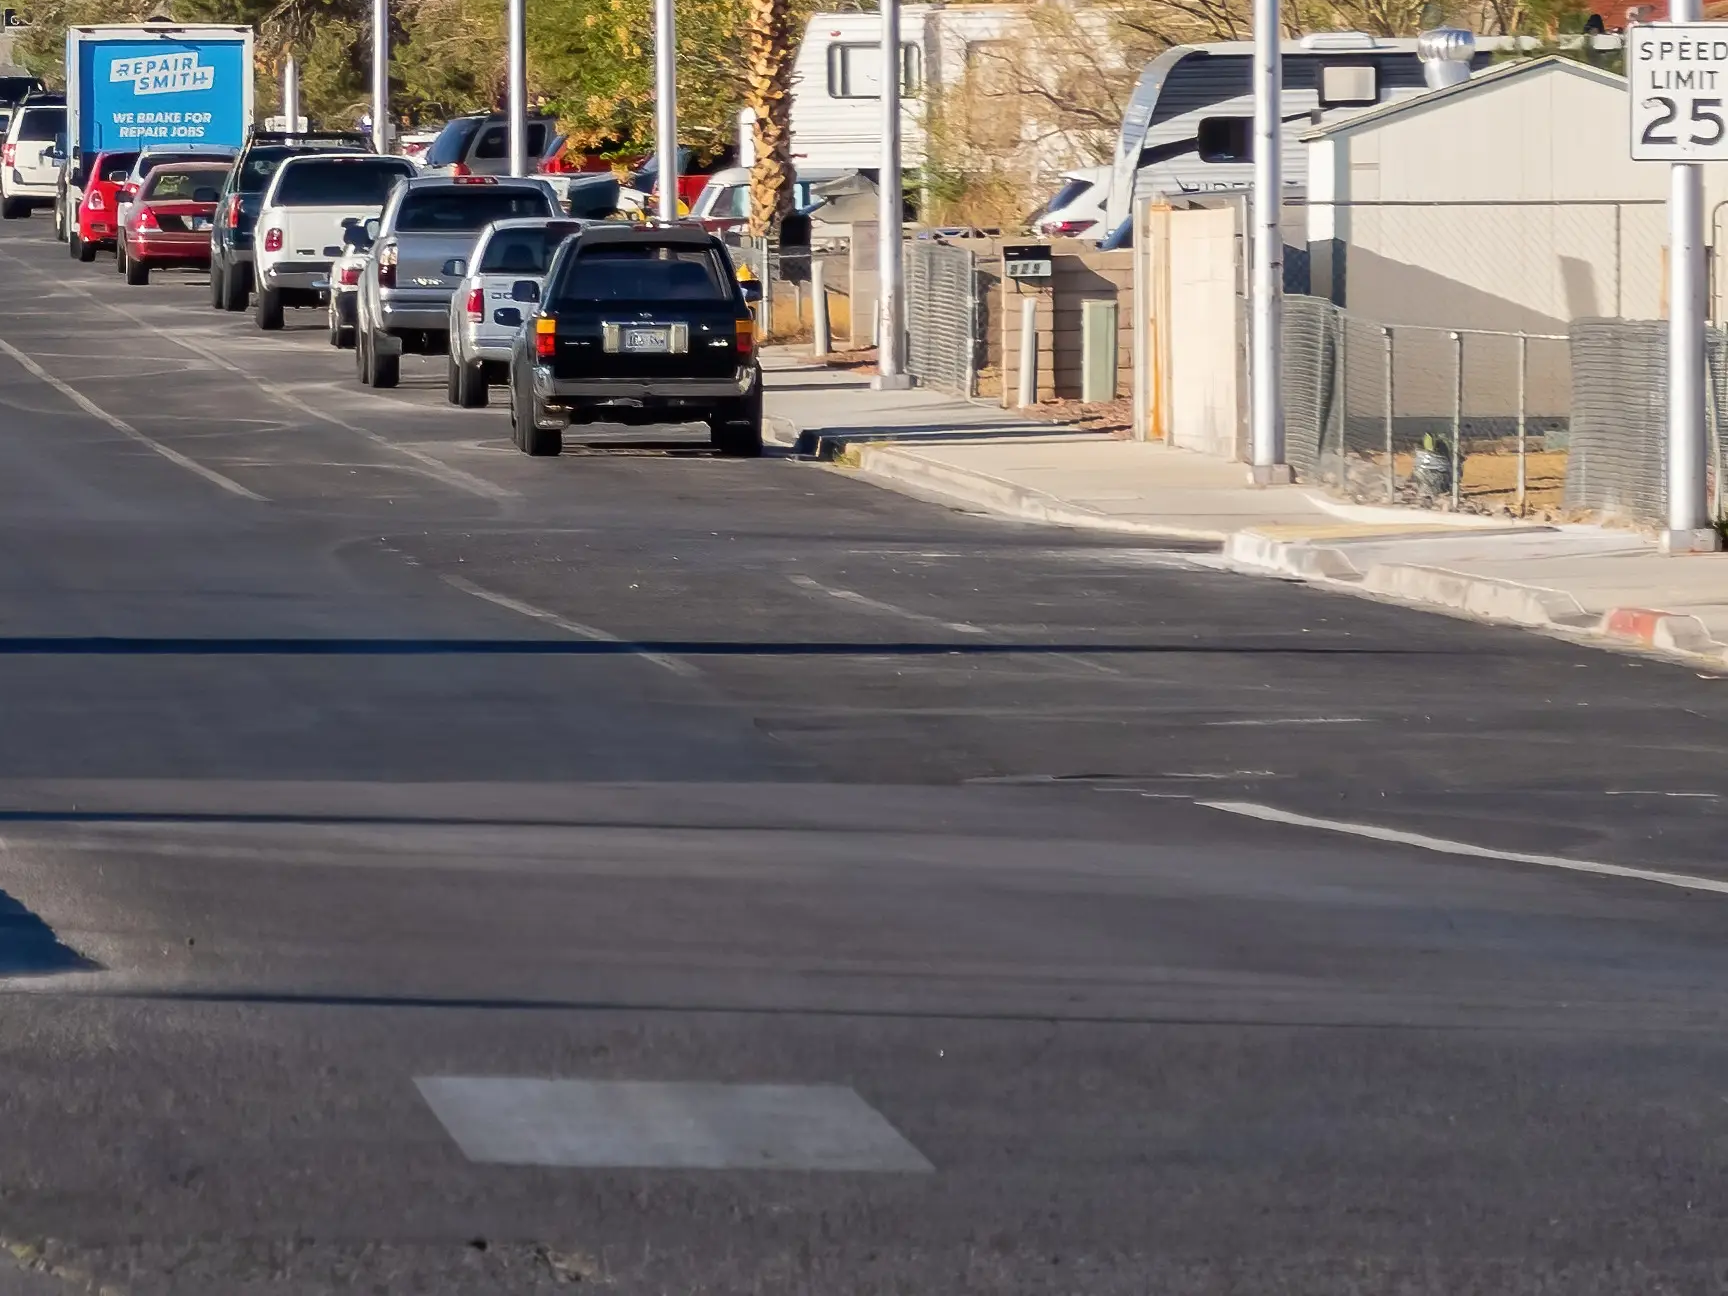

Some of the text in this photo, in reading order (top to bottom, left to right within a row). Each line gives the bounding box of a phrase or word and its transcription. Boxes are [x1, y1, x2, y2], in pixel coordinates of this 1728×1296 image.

[1640, 41, 1728, 61] SPEED
[116, 57, 193, 77] REPAIR
[139, 71, 208, 90] SMITH
[1651, 70, 1720, 90] LIMIT
[113, 112, 212, 124] WE BRAKE FOR
[1641, 96, 1725, 146] 25
[119, 126, 205, 138] REPAIR JOBS
